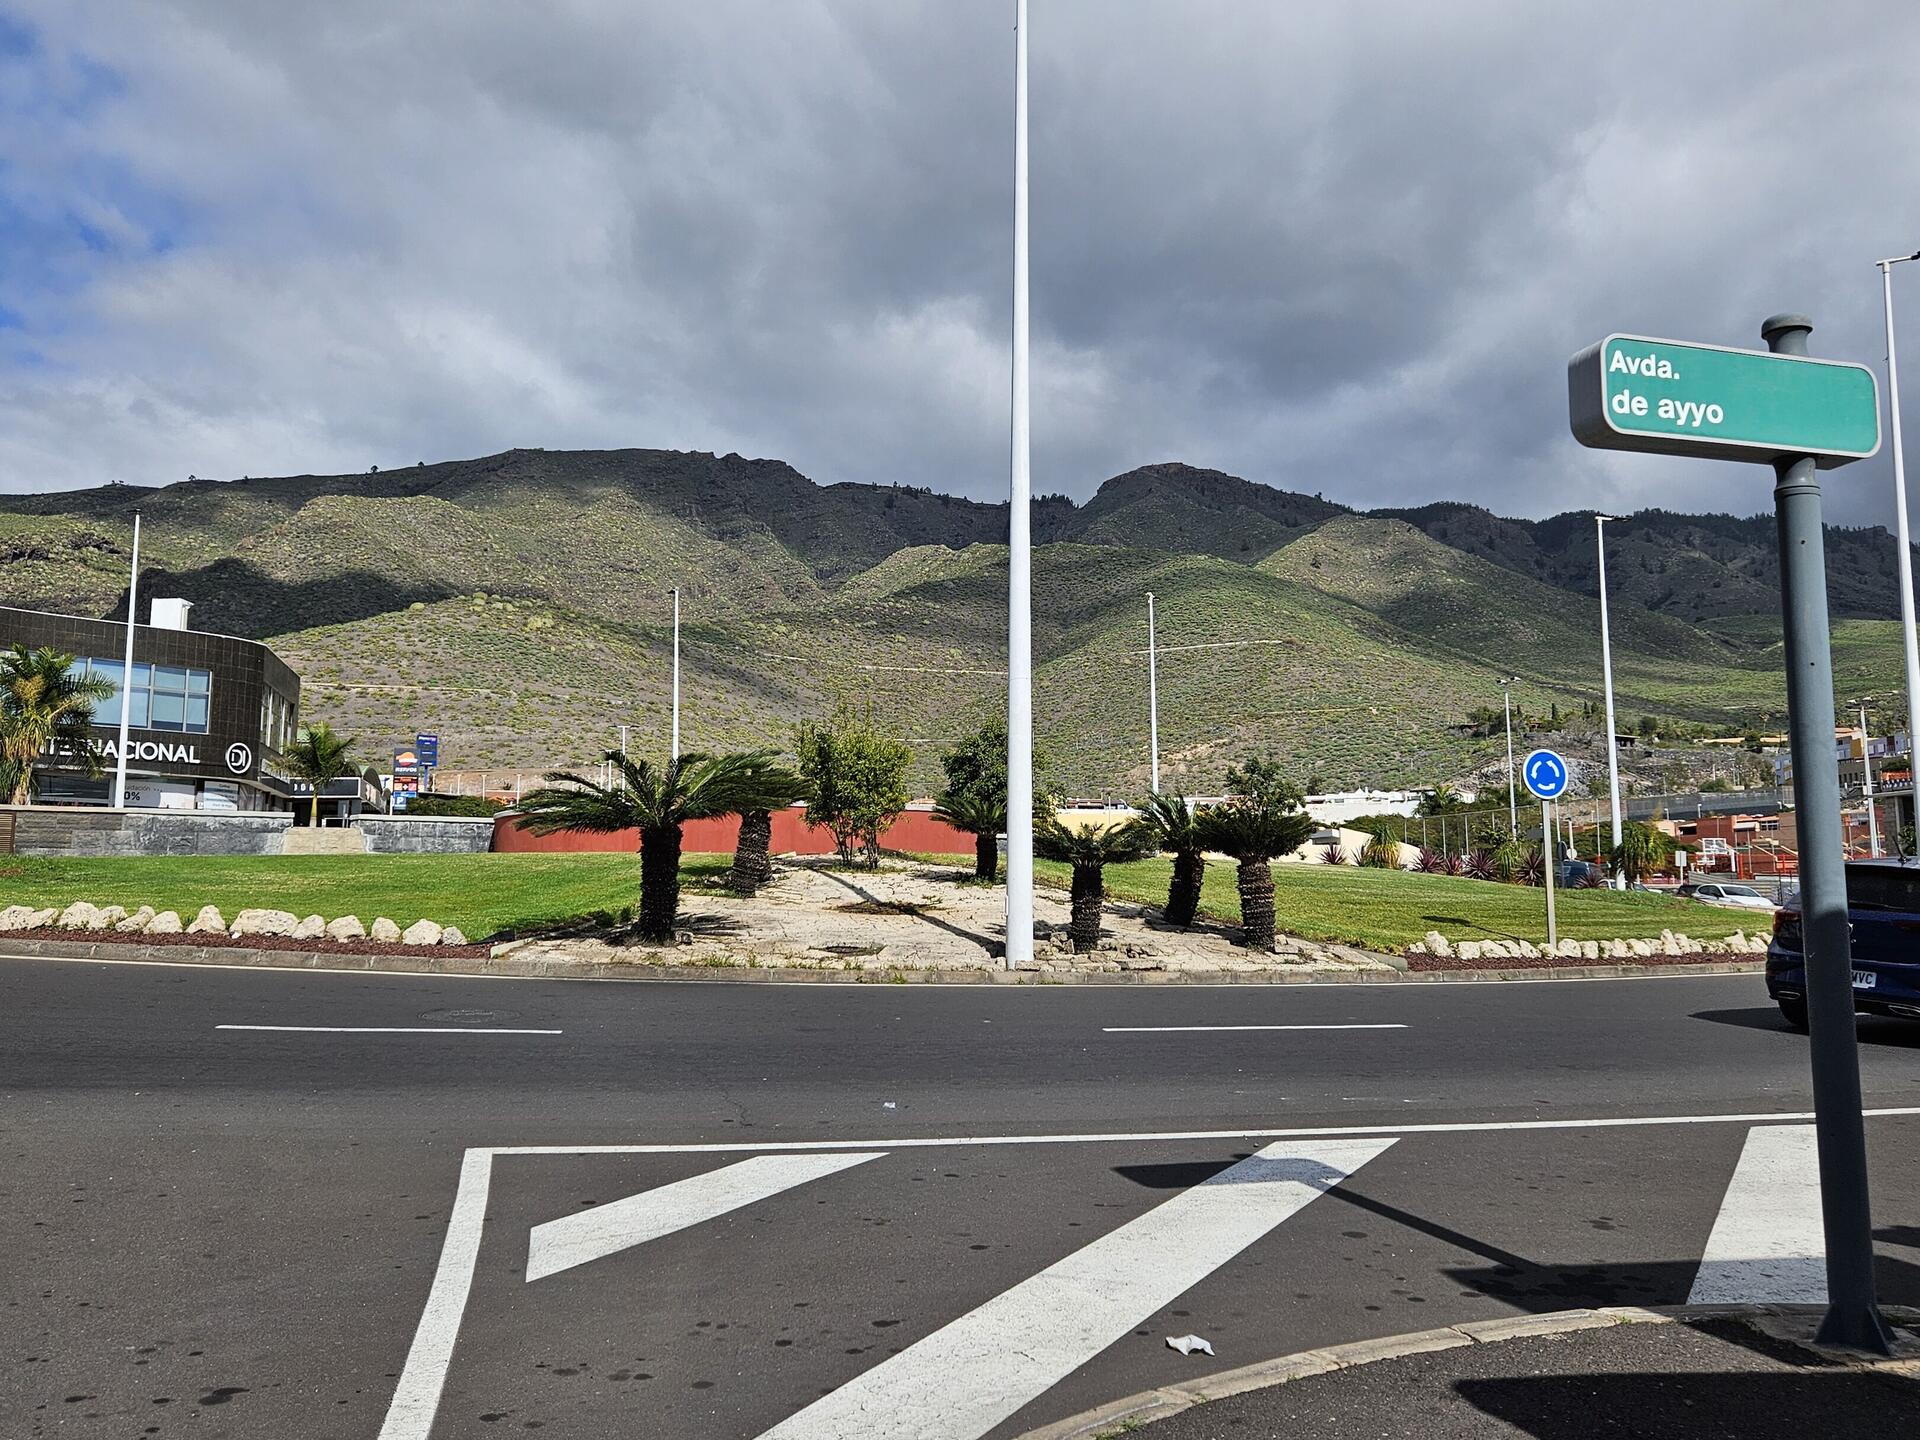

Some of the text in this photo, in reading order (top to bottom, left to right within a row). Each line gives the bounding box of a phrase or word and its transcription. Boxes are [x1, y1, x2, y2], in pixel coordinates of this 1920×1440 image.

[1610, 350, 1680, 379] Avda.
[1612, 390, 1724, 427] de ayyo
